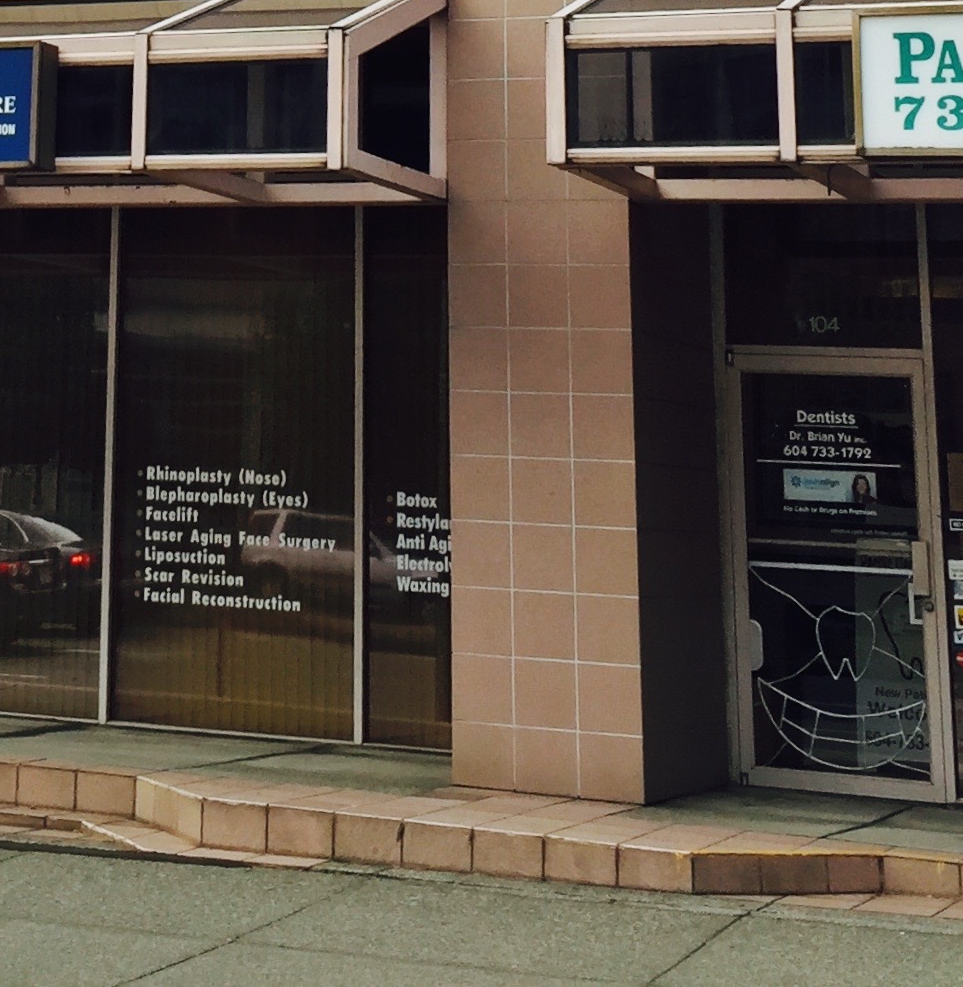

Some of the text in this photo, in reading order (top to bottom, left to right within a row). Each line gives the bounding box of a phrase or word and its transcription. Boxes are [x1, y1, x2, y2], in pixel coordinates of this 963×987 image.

[809, 315, 840, 333] 104
[796, 409, 857, 425] Dentists
[789, 430, 805, 442] Dr.
[807, 430, 835, 444] Brian
[837, 432, 852, 444] Yu
[783, 445, 872, 460] 604 733-1792
[145, 466, 287, 487] Rhinoplasty (Nose)
[145, 488, 309, 509] Blepharoplasty (Eyes)
[396, 490, 438, 509] Botox
[144, 505, 199, 523] Facelift
[145, 527, 336, 552] Laser Aging Face Surgery
[396, 533, 426, 551] Anti
[144, 546, 226, 566] Liposuction
[396, 553, 451, 574] Electrol
[144, 566, 244, 587] Scar Revision
[396, 575, 451, 599] Waxing
[143, 587, 301, 612] Facial Reconstruction
